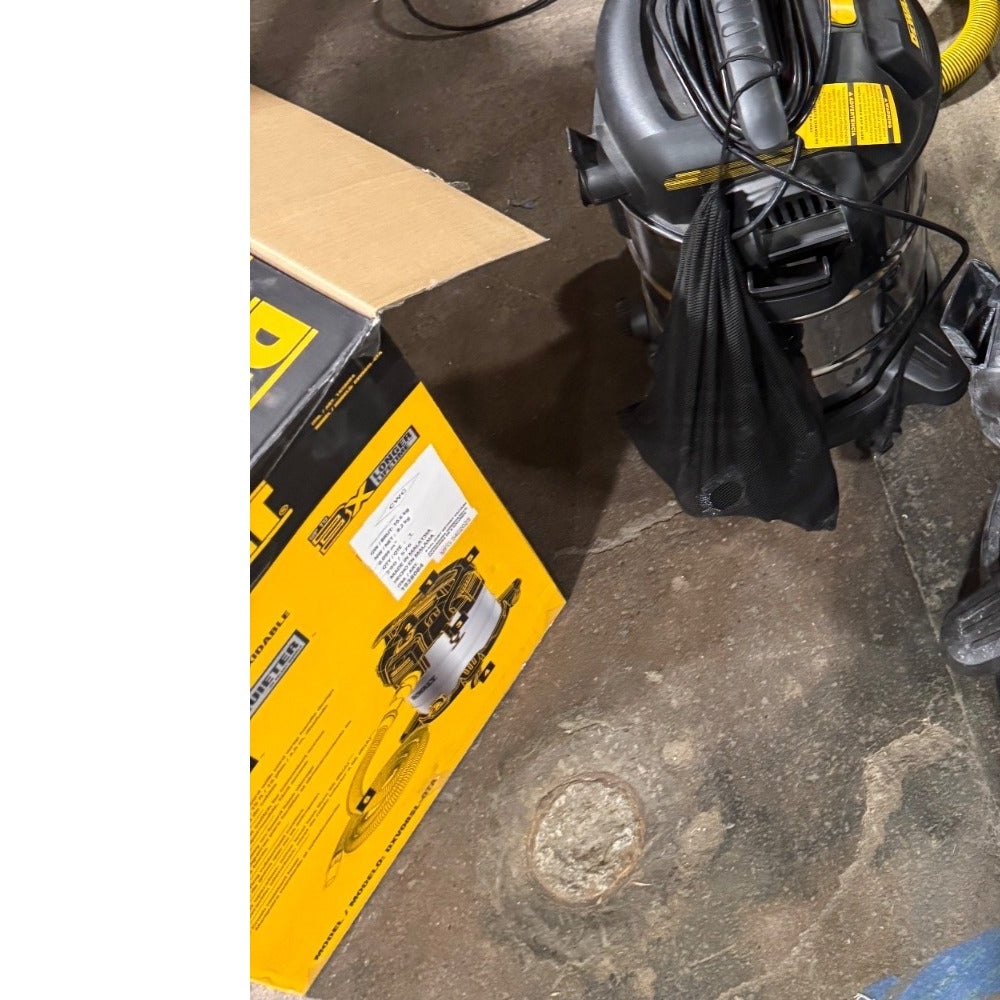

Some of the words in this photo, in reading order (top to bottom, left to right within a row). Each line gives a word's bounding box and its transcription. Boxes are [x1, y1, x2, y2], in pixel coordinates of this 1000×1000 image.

[373, 432, 412, 479] LONGER
[388, 487, 407, 510] CWC
[389, 562, 403, 578] MADE
[408, 528, 431, 555] MALAYSIA
[250, 610, 290, 664] IDABLE
[250, 640, 299, 712] UIETER
[313, 918, 343, 961] MODEL
